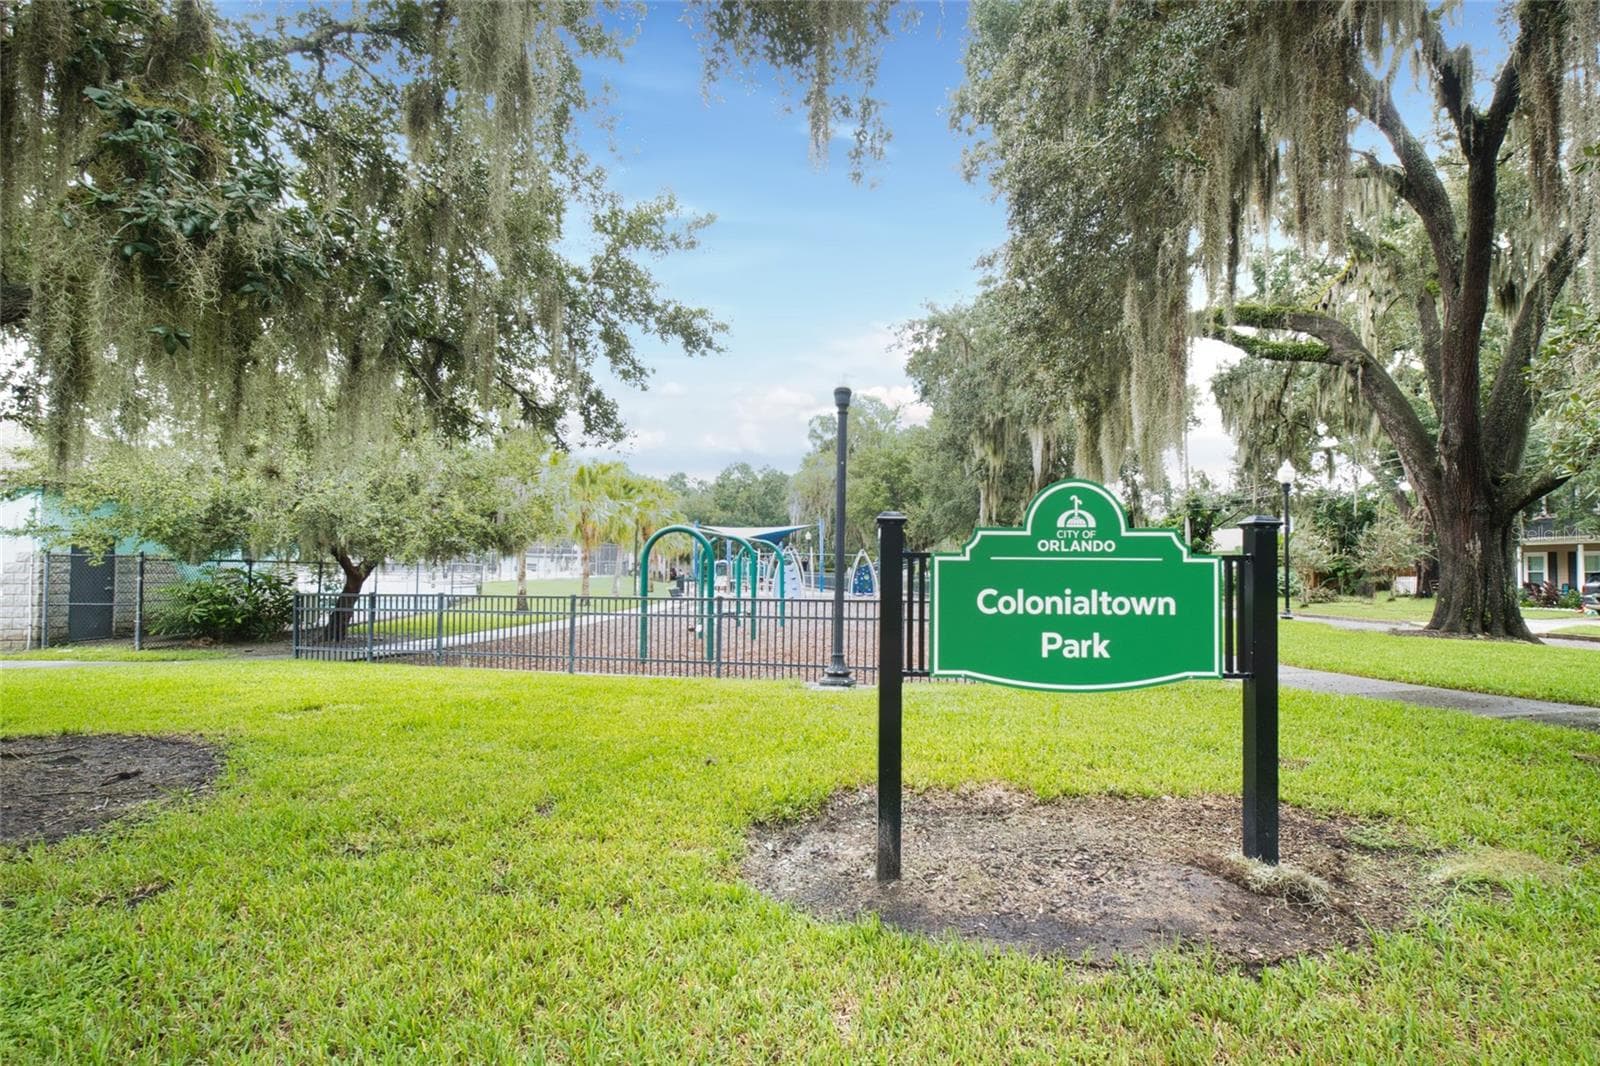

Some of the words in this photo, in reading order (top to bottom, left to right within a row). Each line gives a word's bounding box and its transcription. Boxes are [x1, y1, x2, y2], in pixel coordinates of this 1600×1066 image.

[1056, 530, 1080, 539] CITY
[1082, 530, 1096, 539] OF
[1037, 539, 1116, 552] ORLANDO
[976, 588, 1176, 616] Colonialtown
[1041, 631, 1110, 659] Park
